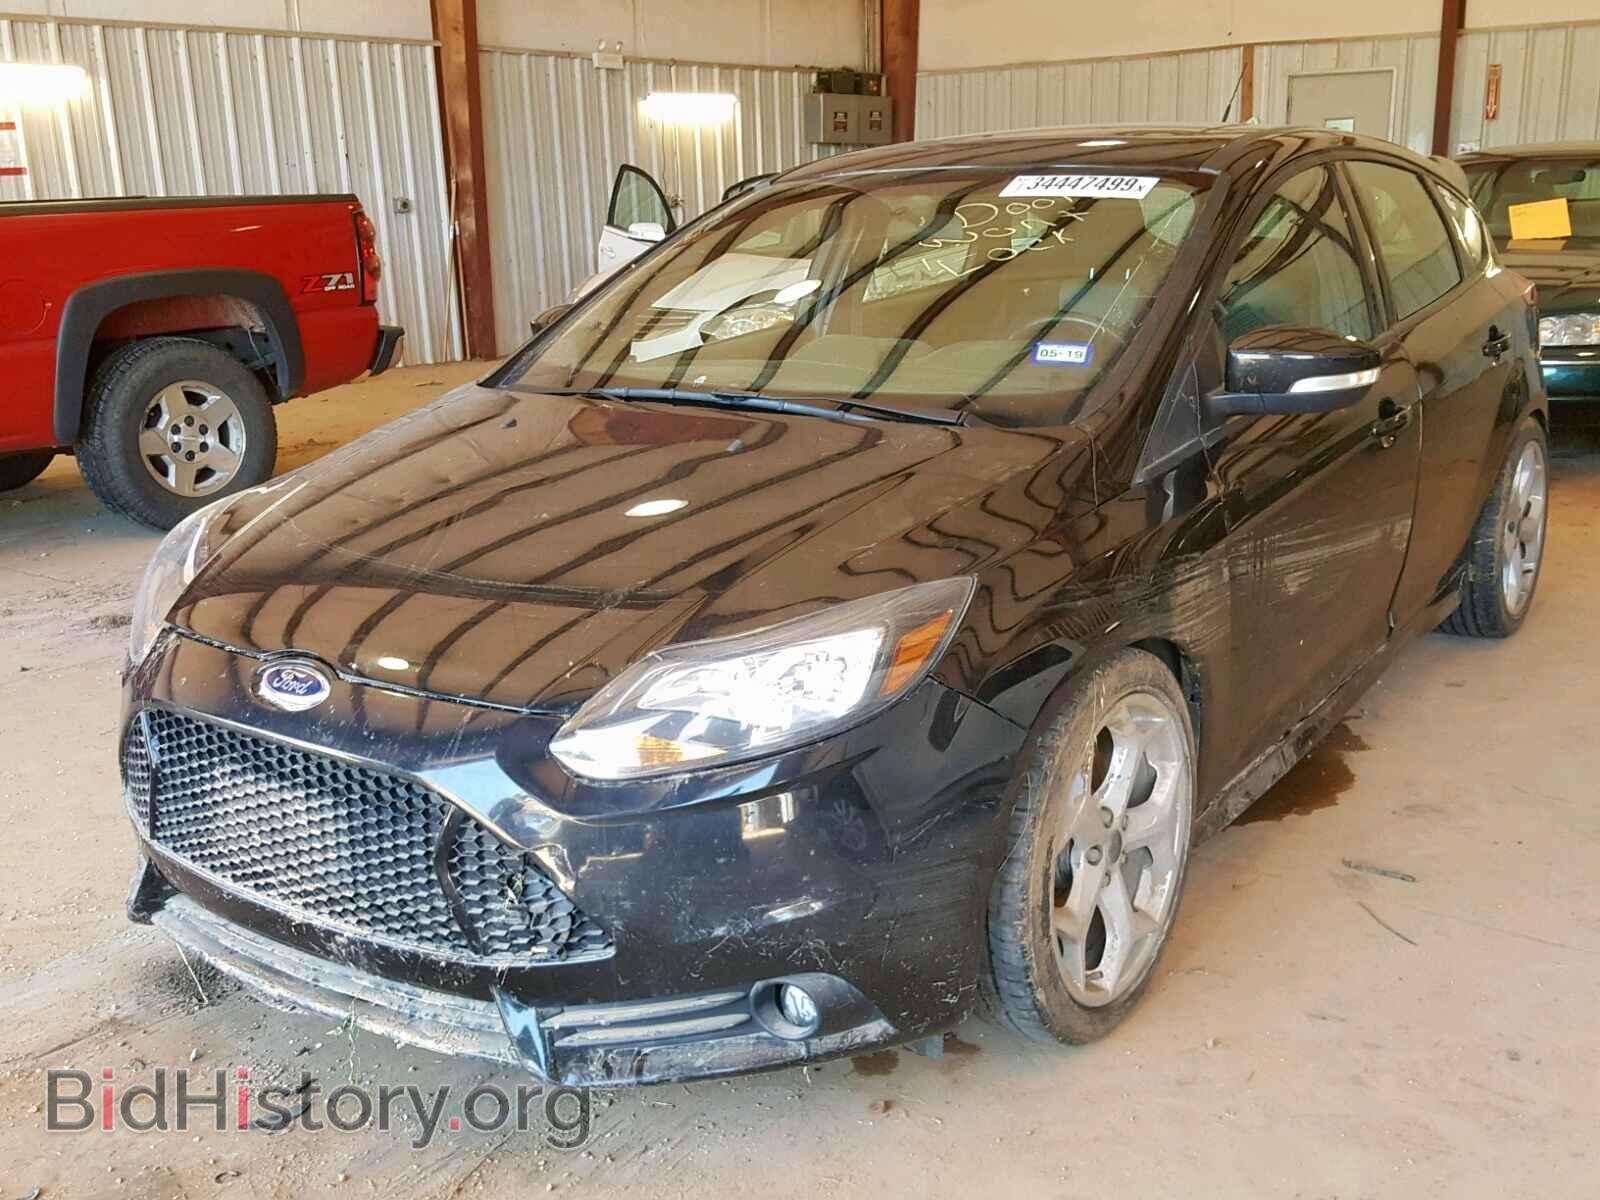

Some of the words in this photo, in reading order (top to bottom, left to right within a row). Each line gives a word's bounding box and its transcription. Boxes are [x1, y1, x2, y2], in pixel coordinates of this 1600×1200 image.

[1026, 176, 1138, 191] 34447499
[303, 272, 354, 292] Z71
[272, 669, 314, 695] Ford
